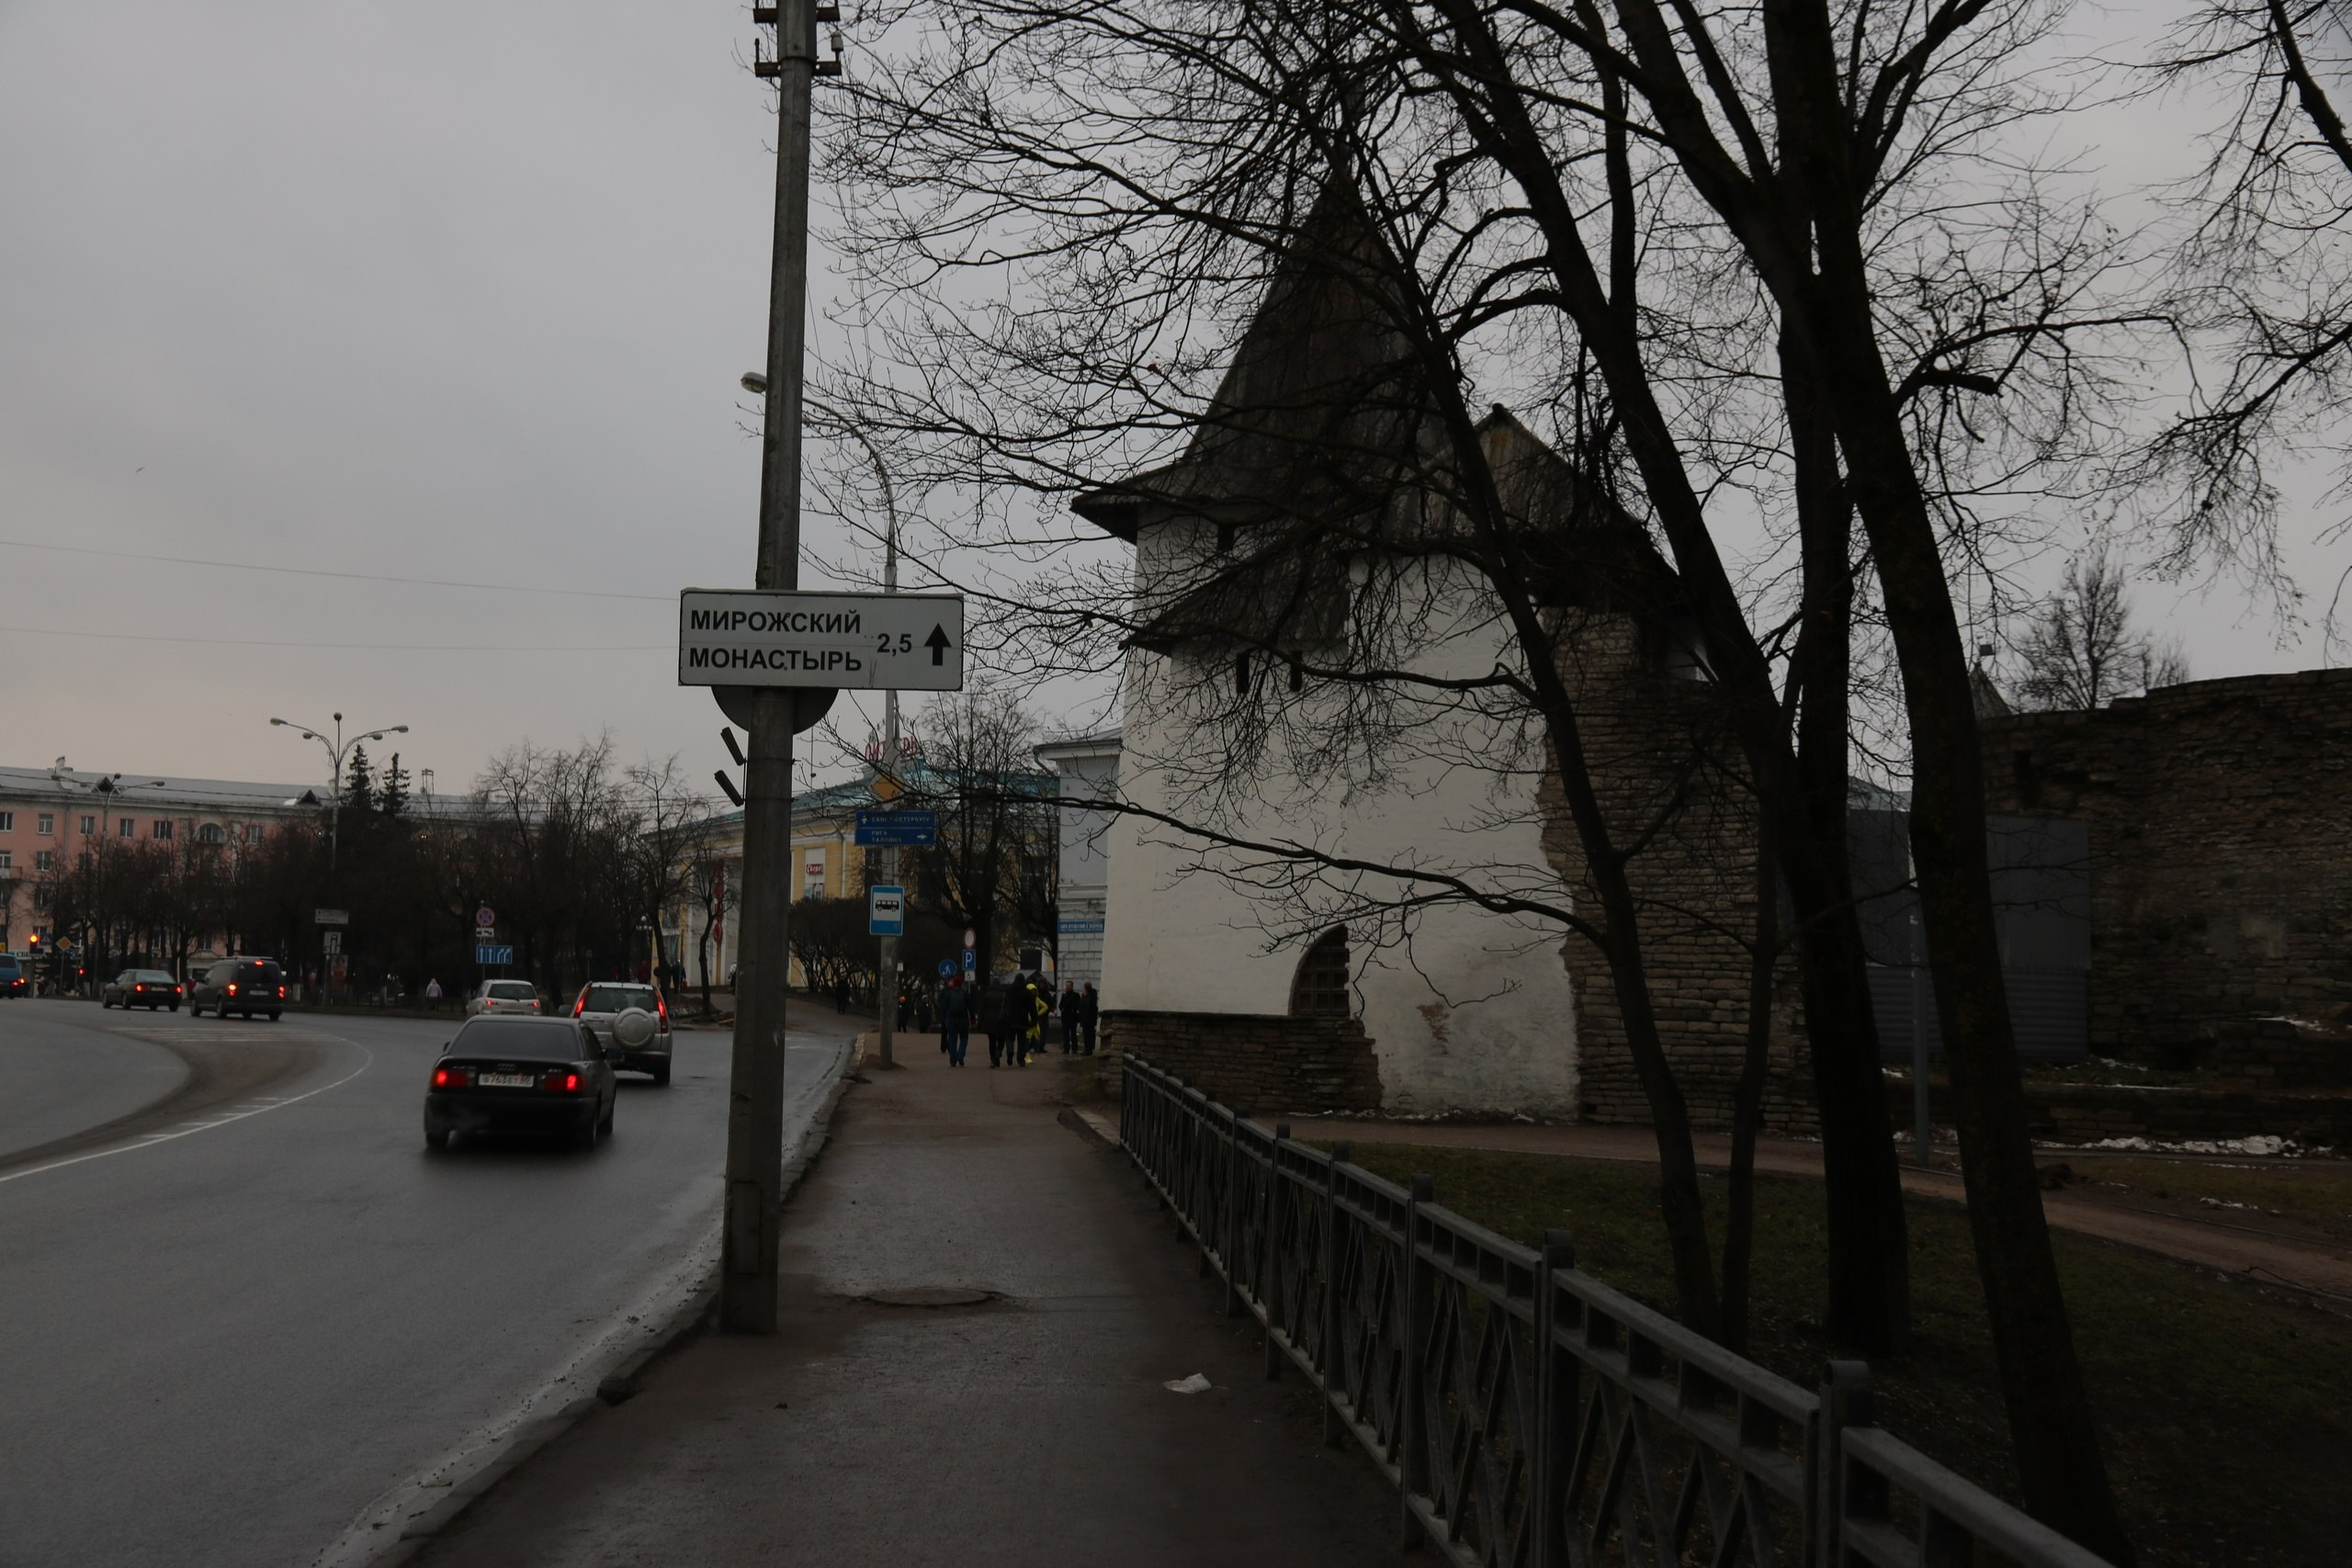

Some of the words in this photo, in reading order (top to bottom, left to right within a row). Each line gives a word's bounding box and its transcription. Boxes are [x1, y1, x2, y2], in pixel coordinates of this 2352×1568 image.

[691, 609, 861, 634] МИРОЖСКИЙ
[876, 633, 912, 656] 2,5
[689, 647, 862, 671] МОНАСТЫРЬ
